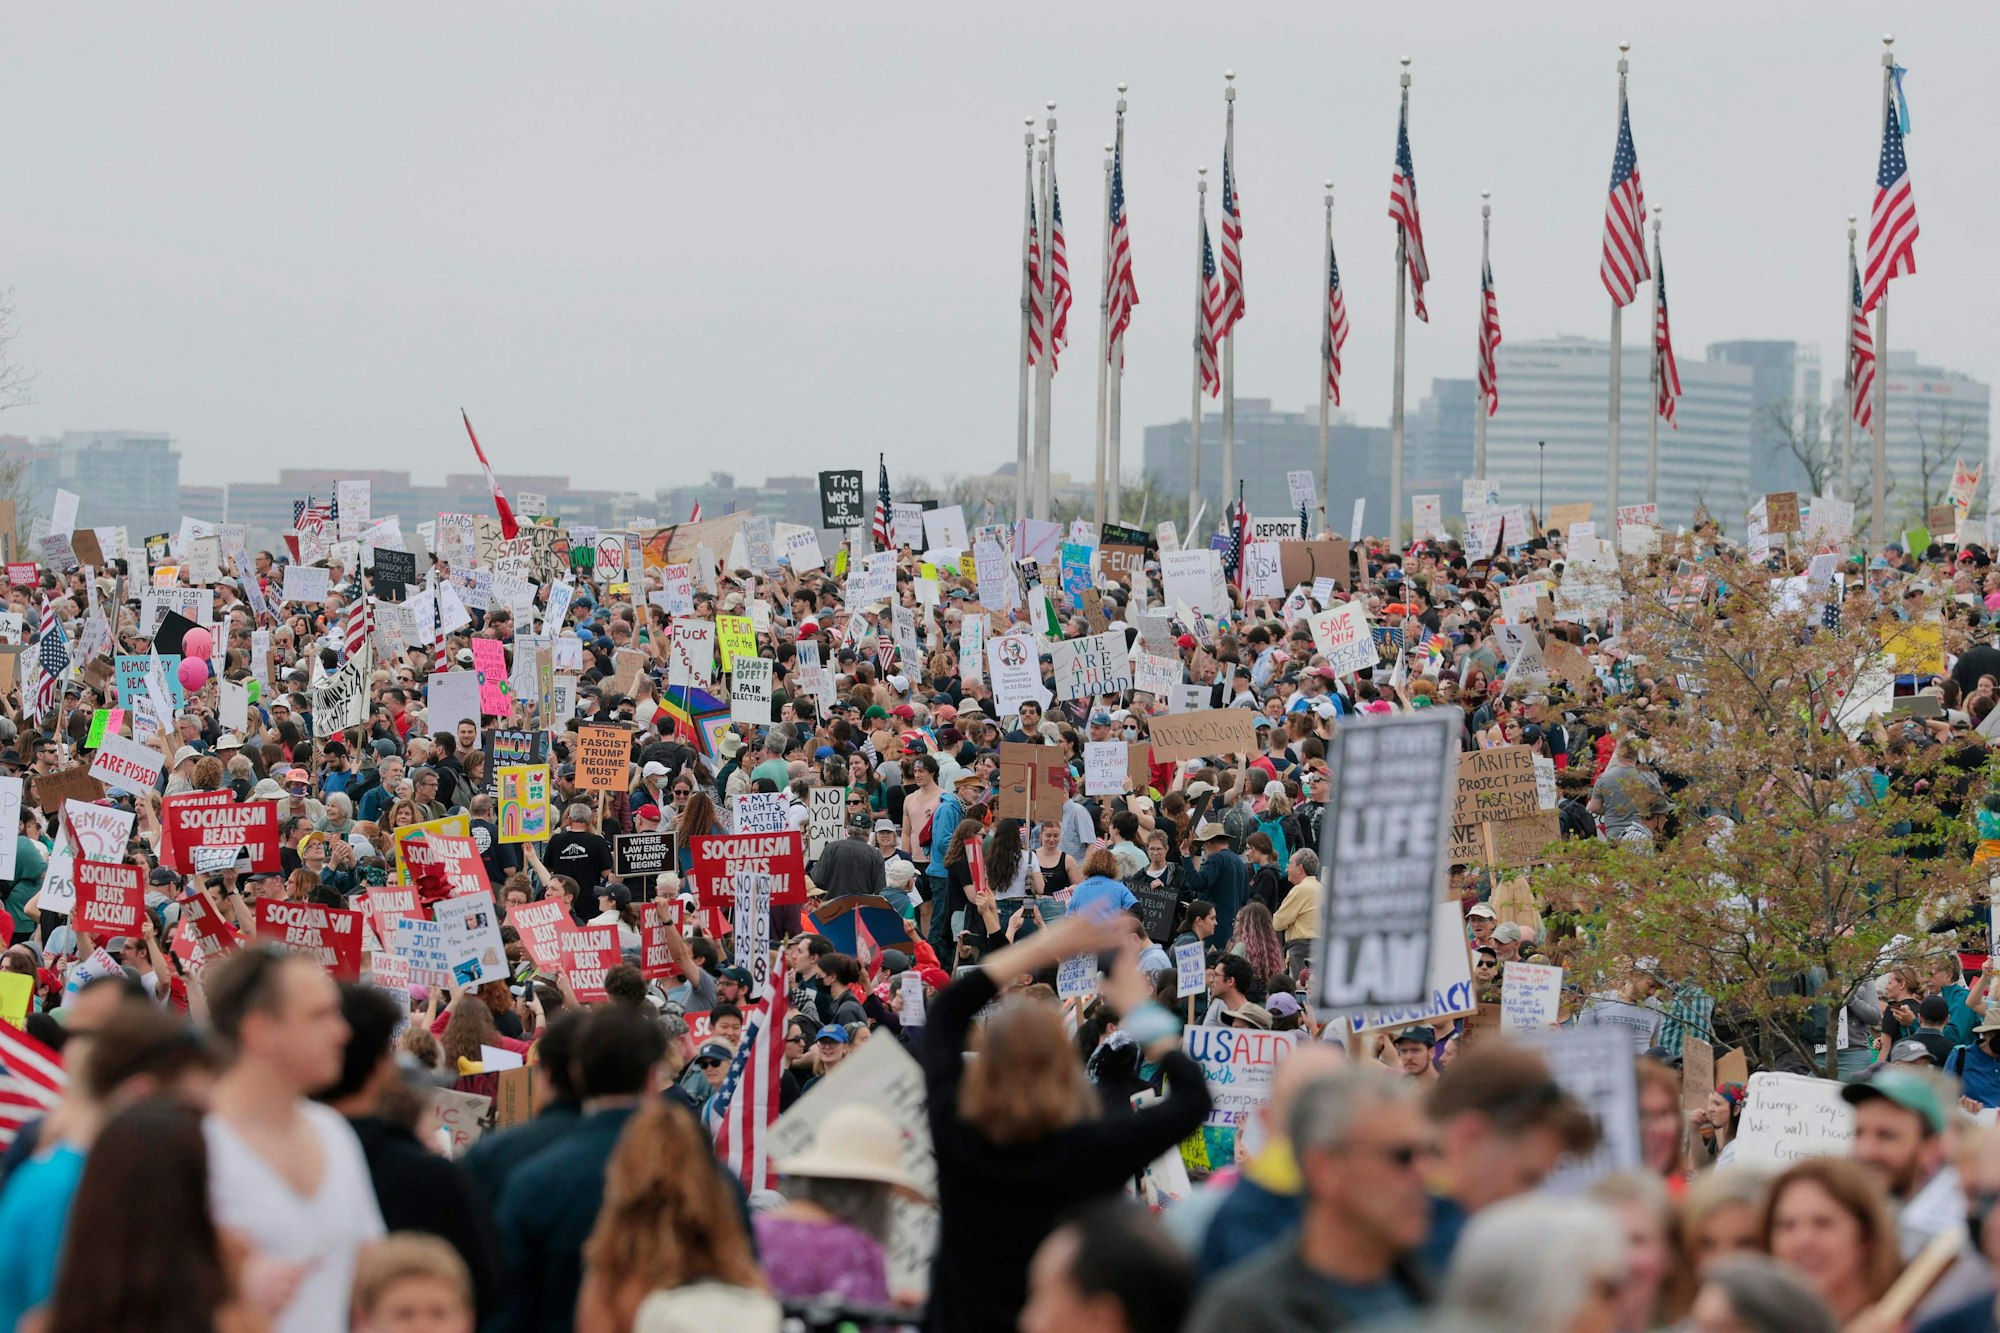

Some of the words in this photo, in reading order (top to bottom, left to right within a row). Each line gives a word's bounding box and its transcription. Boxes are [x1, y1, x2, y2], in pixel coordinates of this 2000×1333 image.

[830, 475, 859, 489] The
[836, 503, 849, 515] IS
[1256, 523, 1297, 537] DEPORT
[497, 537, 532, 559] SAVE
[787, 536, 817, 551] TRUTH
[393, 554, 411, 565] BACK
[597, 547, 622, 568] DOGE
[1168, 553, 1201, 564] Vaccines
[8, 565, 35, 573] FREEDOM
[376, 562, 401, 573] FREEDOM
[404, 565, 413, 573] OF
[498, 561, 512, 571] US
[1023, 564, 1034, 572] BE
[1167, 568, 1185, 577] Save
[1187, 568, 1206, 577] Lives
[452, 567, 471, 577] DOES
[474, 571, 491, 581] THIS
[147, 586, 203, 598] American
[721, 618, 728, 634] F
[732, 618, 752, 634] Elon
[1320, 613, 1355, 637] SAVE
[727, 638, 740, 649] and
[741, 639, 753, 650] the
[1332, 630, 1354, 645] NIH
[1072, 636, 1105, 655] WE
[121, 660, 172, 673] DEMOCCY
[1071, 651, 1112, 672] ARE
[1071, 666, 1113, 685] THE
[739, 683, 761, 695] FAIR
[1070, 677, 1129, 700] FLOOD
[732, 692, 770, 703] ELECTIONS
[595, 730, 616, 739] The
[1204, 719, 1253, 743] People
[493, 731, 532, 761] NO!
[580, 738, 629, 748] FASCIST
[584, 748, 624, 757] TRUMP
[1094, 747, 1105, 757] It's
[1106, 746, 1117, 755] not
[95, 752, 124, 773] ARE
[123, 761, 158, 786] PISSED
[581, 758, 625, 768] REGIME
[1088, 759, 1104, 768] LEFT
[1109, 758, 1126, 767] RIGHT
[1468, 750, 1534, 774] TARIFFS!
[586, 767, 619, 776] MUST
[1101, 769, 1113, 778] It's
[592, 777, 612, 786] GO!
[1458, 774, 1511, 792] PROJECT
[1513, 773, 1537, 784] 2025
[751, 793, 771, 803] MY
[815, 789, 840, 805] NO
[741, 802, 781, 813] RIGHTS
[811, 806, 840, 821] YOU
[180, 807, 267, 829] SOCIALISM
[740, 810, 787, 826] MATTER
[202, 827, 246, 845] BEATS
[1337, 808, 1437, 858] LIFE
[623, 844, 642, 854] LAW
[643, 843, 669, 853] ENDS,
[630, 836, 661, 846] WHERE
[702, 836, 790, 860] SOCIALISM
[197, 858, 231, 871] HANDS
[625, 852, 667, 862] TYRANNY
[630, 860, 662, 870] BEGINS
[725, 858, 770, 877] BEATS
[80, 864, 137, 889] SOCIALISM
[736, 875, 750, 893] NO
[95, 885, 125, 904] BEATS
[737, 896, 750, 912] NO
[1144, 898, 1167, 909] FELON
[84, 900, 136, 926] FASCISM!
[438, 907, 466, 922] America
[514, 902, 564, 929] SOCIALISM
[1148, 910, 1158, 918] OF
[400, 919, 413, 929] NO
[532, 923, 557, 943] BEATS
[561, 929, 612, 952] SOCIALISM
[413, 935, 441, 949] JUST
[395, 946, 408, 956] IF
[412, 946, 427, 958] YOU
[374, 957, 392, 970] SAVE
[394, 958, 409, 973] OUR
[574, 951, 601, 969] BEATS
[1181, 962, 1192, 974] DIES
[1193, 960, 1201, 971] IN
[1325, 934, 1429, 1008] LAW
[1060, 980, 1079, 993] SAVES
[1080, 977, 1098, 990] LIVES
[1180, 974, 1204, 991] SILENCE
[1200, 1062, 1237, 1086] both
[1758, 1076, 1780, 1087] Evil
[1756, 1091, 1799, 1117] Trump
[1814, 1102, 1846, 1123] says
[1749, 1117, 1772, 1134] We
[1784, 1121, 1809, 1137] will
